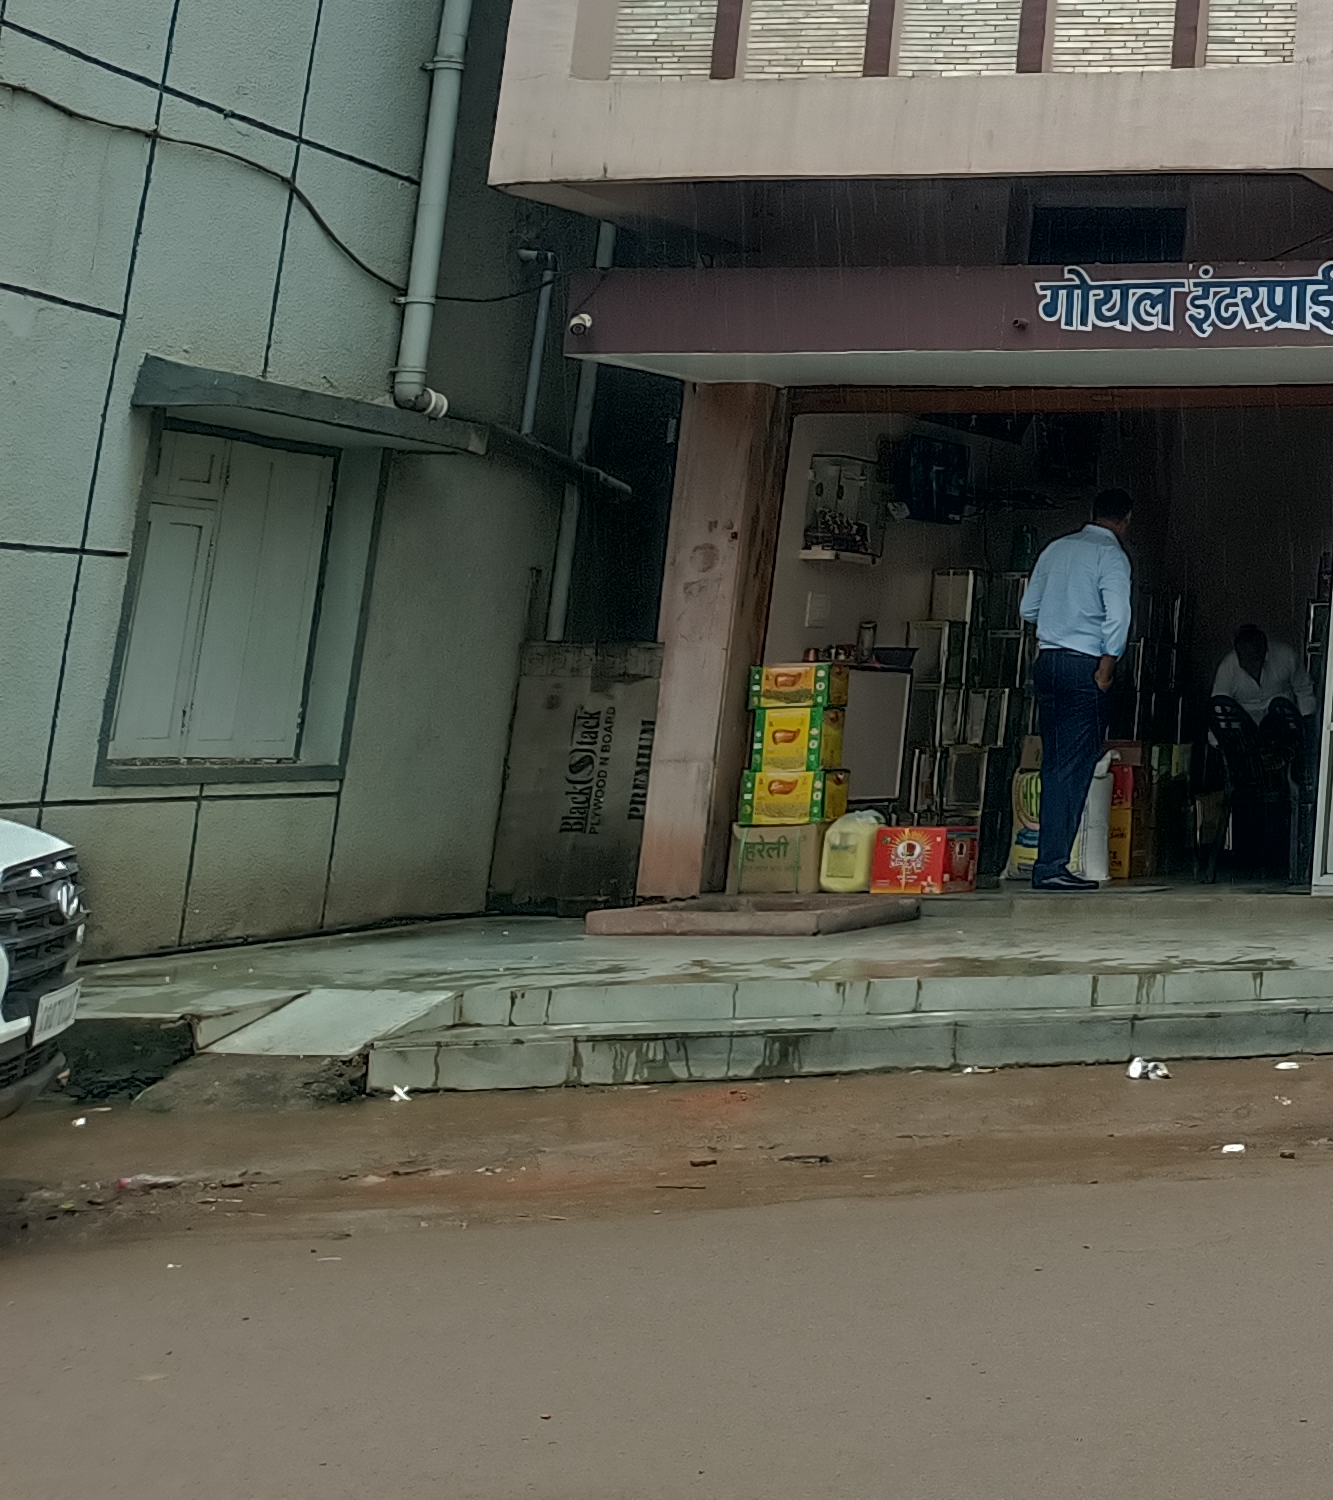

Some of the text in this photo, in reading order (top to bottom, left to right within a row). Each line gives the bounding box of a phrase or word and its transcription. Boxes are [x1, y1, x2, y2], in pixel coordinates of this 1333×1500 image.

[1035, 267, 1187, 331] गोयल
[588, 769, 608, 835] PLYWOOD
[600, 706, 616, 753] BOARD
[627, 720, 656, 820] PREMIUM
